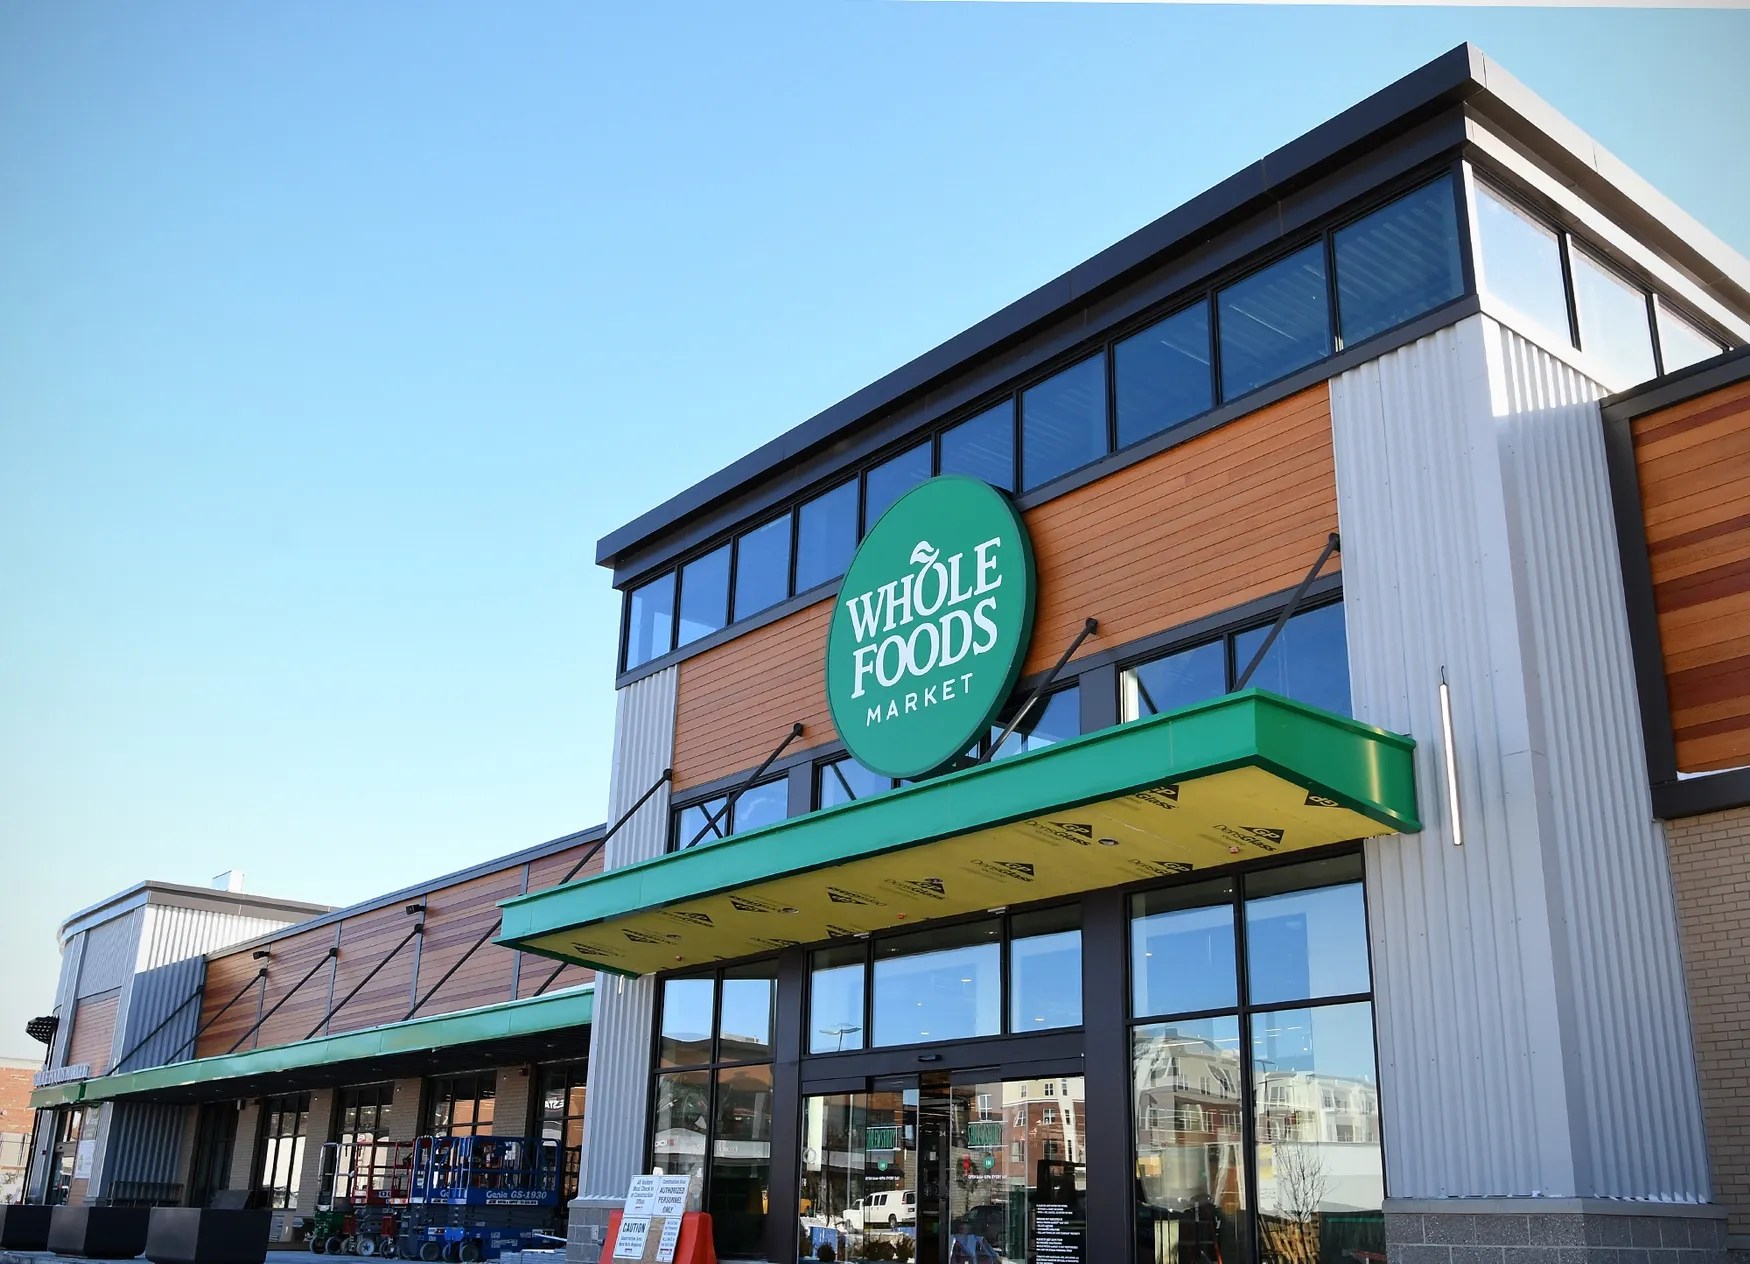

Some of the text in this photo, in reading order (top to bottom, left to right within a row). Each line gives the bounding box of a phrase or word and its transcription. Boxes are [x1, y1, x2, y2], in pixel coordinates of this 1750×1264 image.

[846, 536, 1002, 643] WHOLE
[851, 597, 998, 699] FOODS
[866, 673, 973, 726] MARKET
[1252, 828, 1280, 839] GP
[486, 1190, 547, 1199] Genie GS-1930
[622, 1222, 646, 1233] CAUTION
